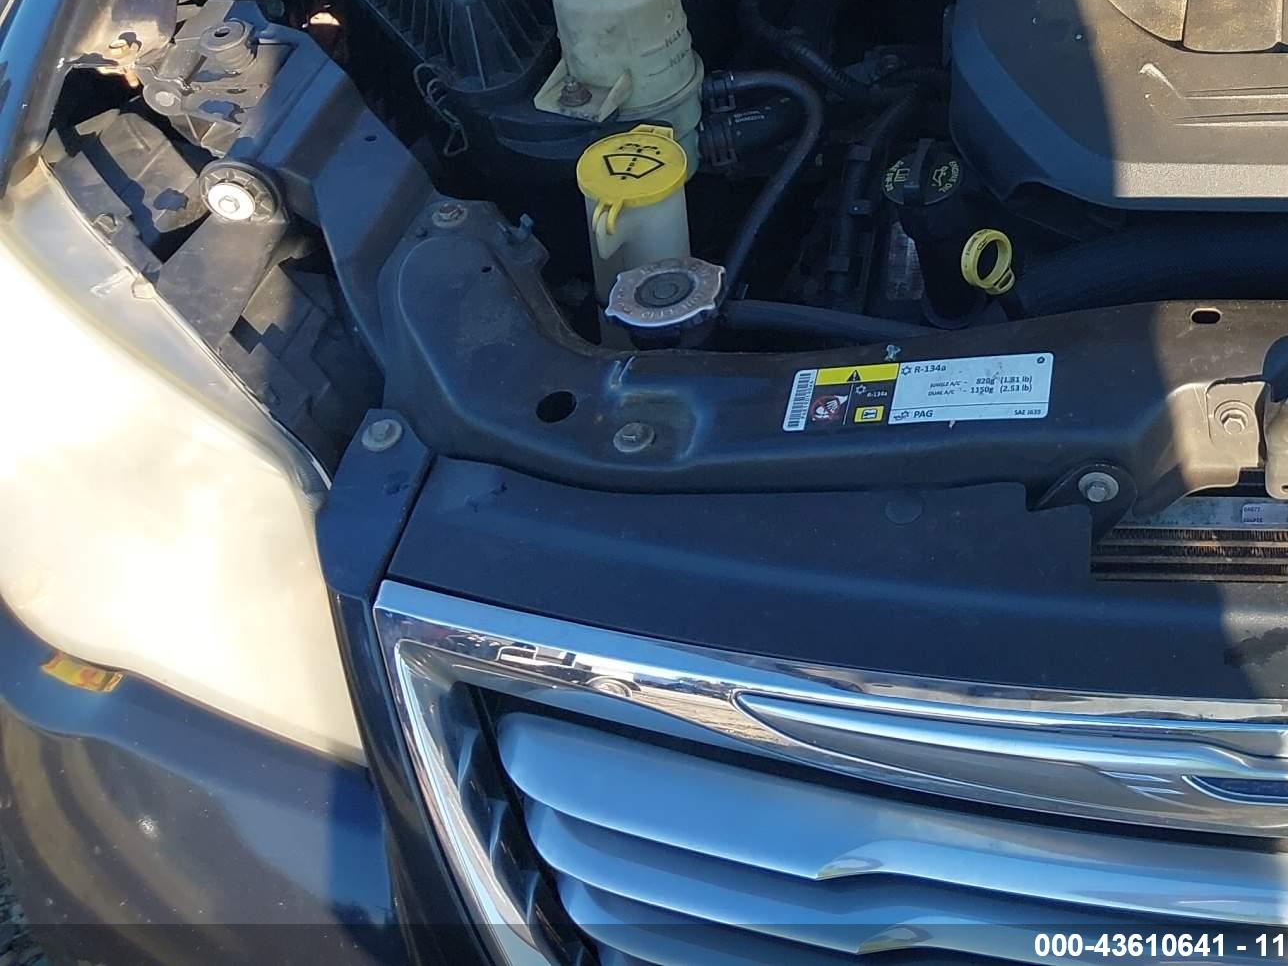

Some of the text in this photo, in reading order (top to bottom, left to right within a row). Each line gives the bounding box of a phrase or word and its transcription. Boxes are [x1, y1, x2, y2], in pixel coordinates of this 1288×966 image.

[938, 161, 959, 192] ENGINE OIL
[914, 364, 947, 374] R-134a
[976, 377, 995, 385] 820g
[1000, 376, 1020, 384] (1.81
[1022, 375, 1033, 384] lb)
[970, 386, 994, 394] 1150g
[1000, 385, 1020, 394] (2.53
[1022, 384, 1033, 393] lb)
[913, 410, 934, 418] PAG
